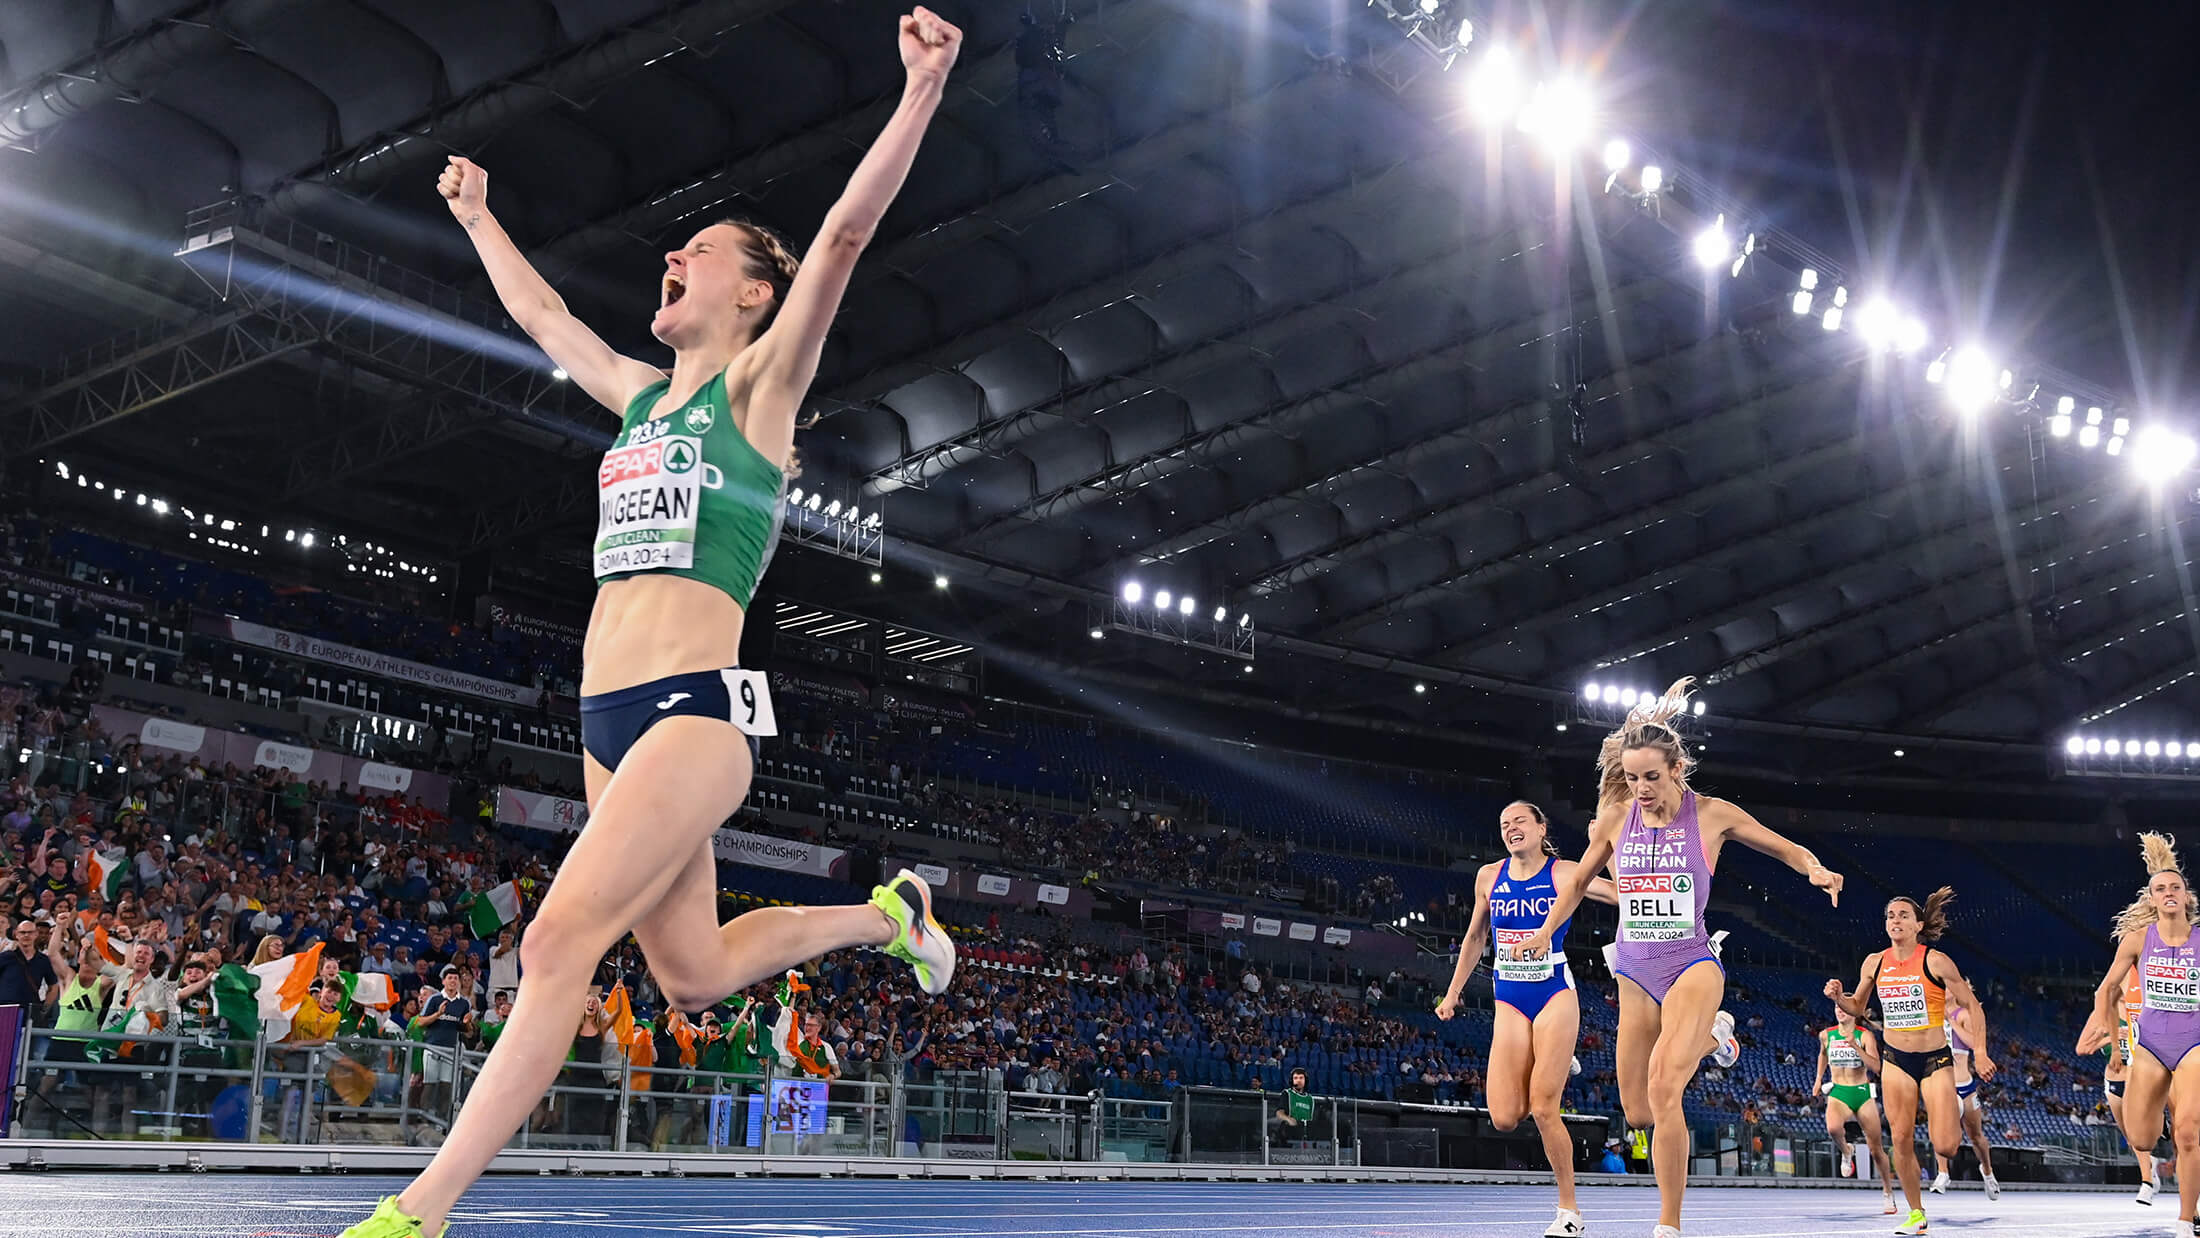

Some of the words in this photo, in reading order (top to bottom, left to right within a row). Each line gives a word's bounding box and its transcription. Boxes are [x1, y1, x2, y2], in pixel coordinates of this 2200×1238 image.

[601, 448, 660, 484] SPAR
[625, 531, 660, 544] CLEAN
[633, 547, 671, 565] 2024
[312, 644, 370, 667] EUROPEAN
[373, 660, 431, 680] ATHLETICS
[433, 673, 517, 699] CHAMPIONSHIPS
[741, 679, 756, 725] 9
[724, 836, 808, 861] CHAMPIONSHIPS
[1622, 841, 1686, 855] GREAT
[1620, 855, 1687, 868] BRITAIN
[1619, 878, 1670, 891] SPAR
[1630, 899, 1682, 916] BELL
[1630, 931, 1655, 939] ROMA
[1658, 931, 1684, 940] 2024
[1498, 947, 1551, 962] GUEMT
[1505, 971, 1526, 979] ROMA
[2146, 966, 2186, 978] SPAR
[2147, 980, 2197, 996] REEKIE
